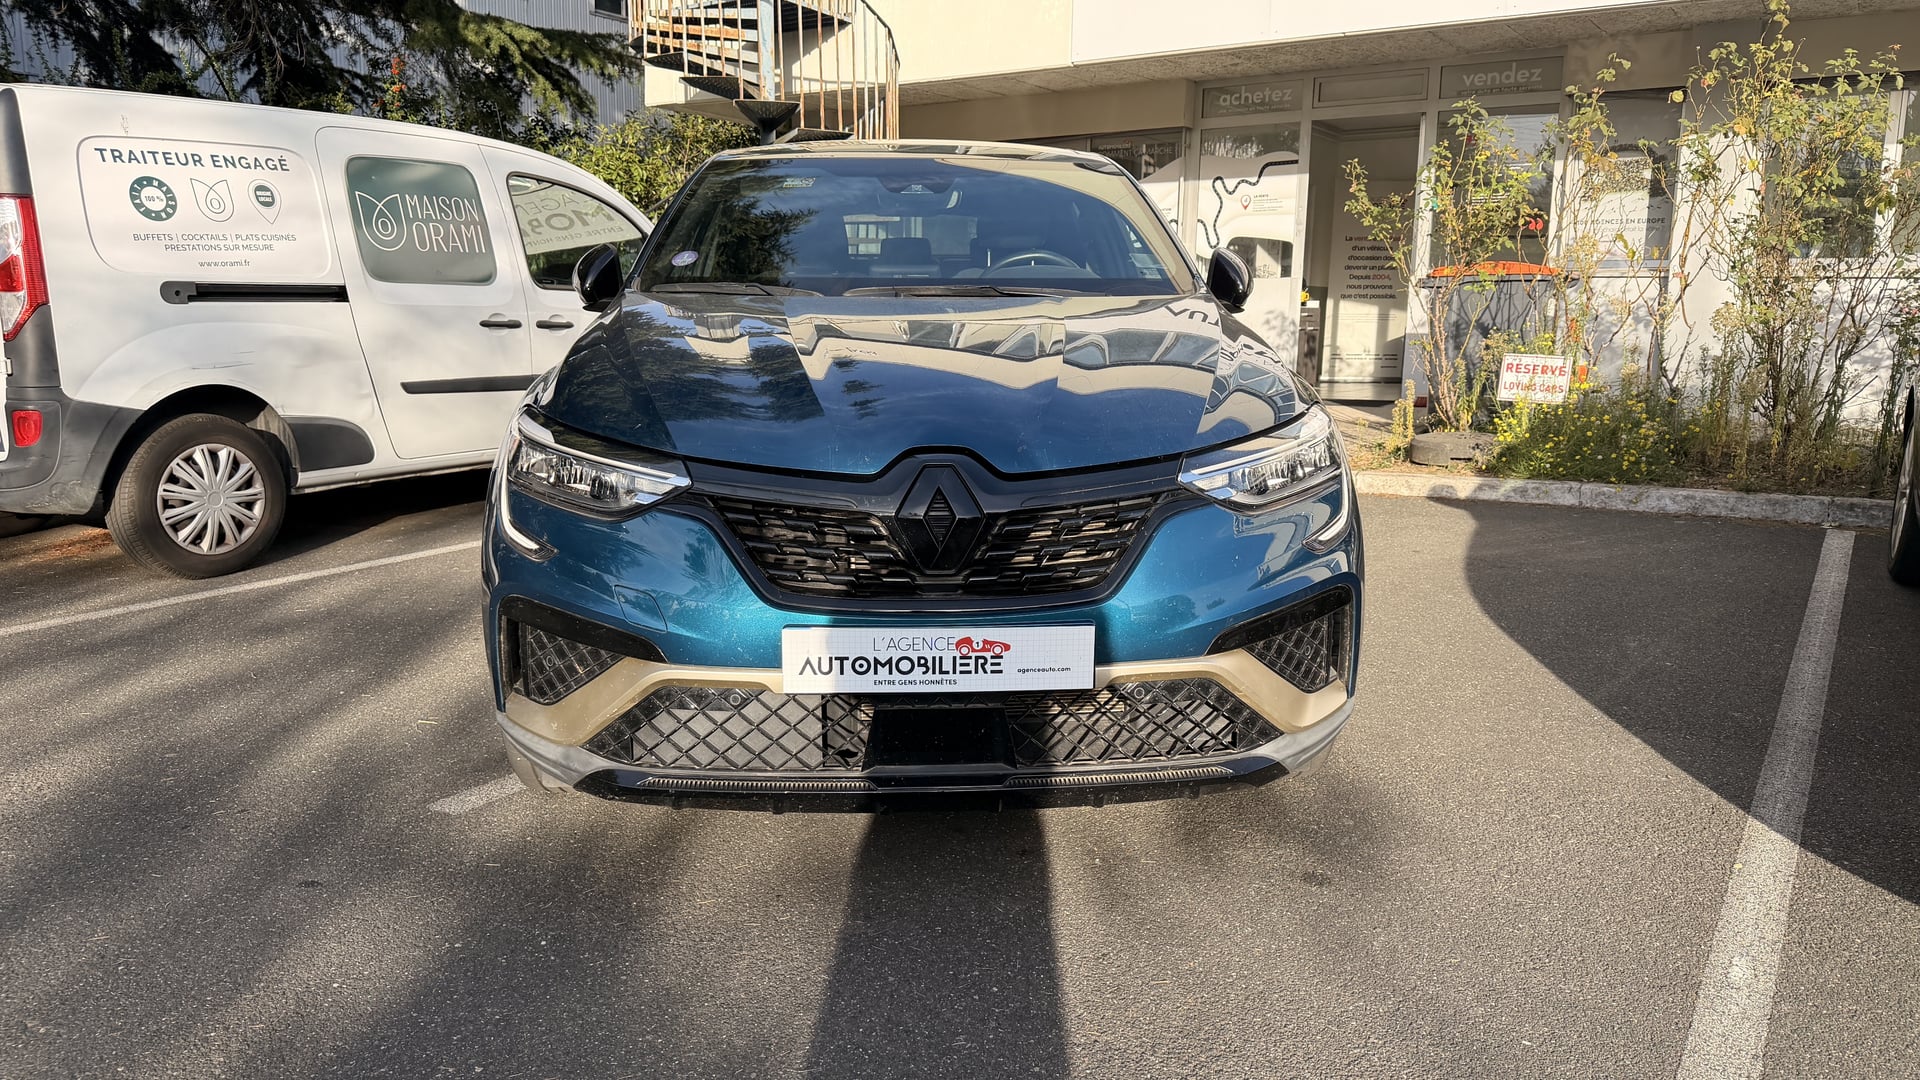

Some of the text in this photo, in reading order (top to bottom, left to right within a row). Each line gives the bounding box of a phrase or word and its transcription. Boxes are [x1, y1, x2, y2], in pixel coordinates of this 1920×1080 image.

[1462, 62, 1543, 87] vendez
[1219, 85, 1293, 106] achetez
[94, 147, 290, 172] TRAITEUR ENGAGÉ
[405, 193, 479, 222] MAISON
[133, 233, 174, 242] BUFFETS
[181, 233, 228, 242] COCKTAILS
[235, 234, 260, 242] PLATS
[412, 221, 486, 254] ORAMI
[165, 244, 275, 252] PRESTATIONS SUR MESURE
[198, 259, 250, 268] www.orami.fr
[1349, 273, 1371, 281] Depuis
[1363, 283, 1393, 291] prouvons
[872, 636, 956, 652] L'AGENCE
[1017, 666, 1073, 675] agenceauto.com
